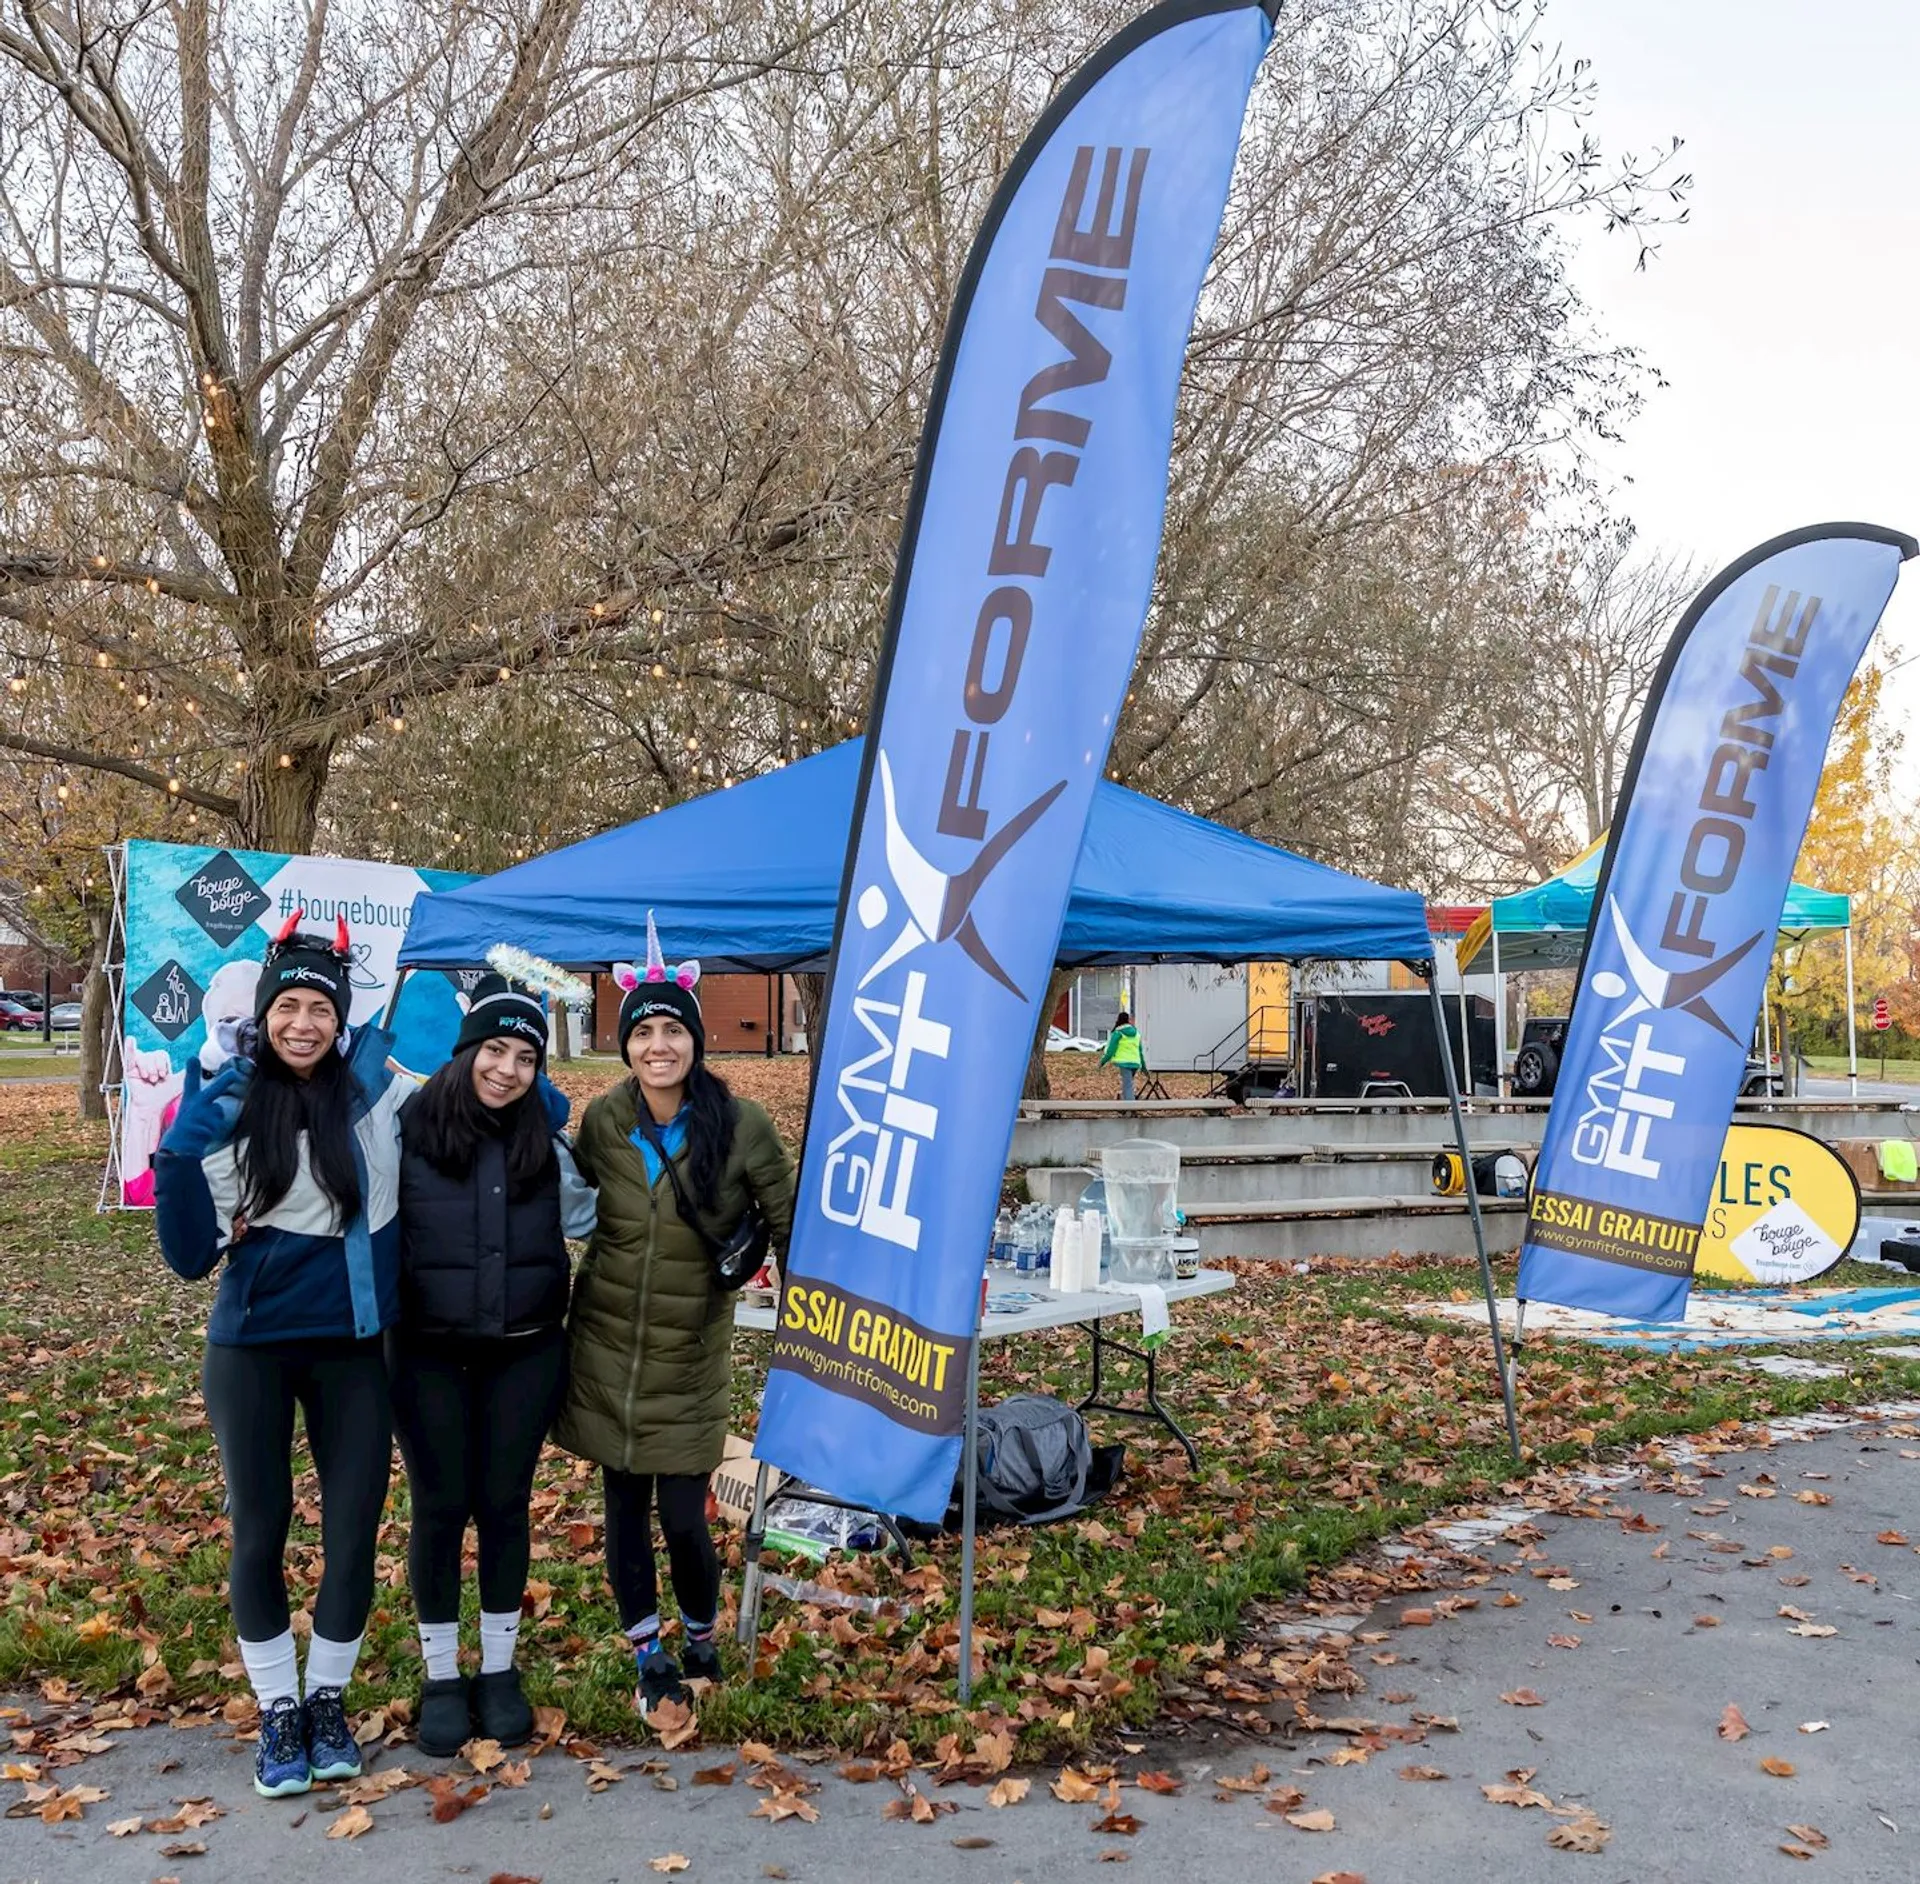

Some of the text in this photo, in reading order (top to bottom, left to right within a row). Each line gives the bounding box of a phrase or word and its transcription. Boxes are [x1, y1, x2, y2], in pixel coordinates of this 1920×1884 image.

[860, 146, 1151, 1252] FIT FORME
[1603, 583, 1823, 1180] FIT FORME
[820, 996, 901, 1228] GYM
[1570, 1035, 1633, 1166] GYM
[1719, 1160, 1791, 1207] LES
[1530, 1194, 1700, 1255] ESSAI GRATUIT
[1753, 1223, 1804, 1243] bouge
[1767, 1235, 1822, 1260] bouge
[779, 1285, 956, 1393] SSAI GRATUIT
[774, 1340, 939, 1421] www.gymfitforme.com
[714, 1472, 755, 1513] NIKE
